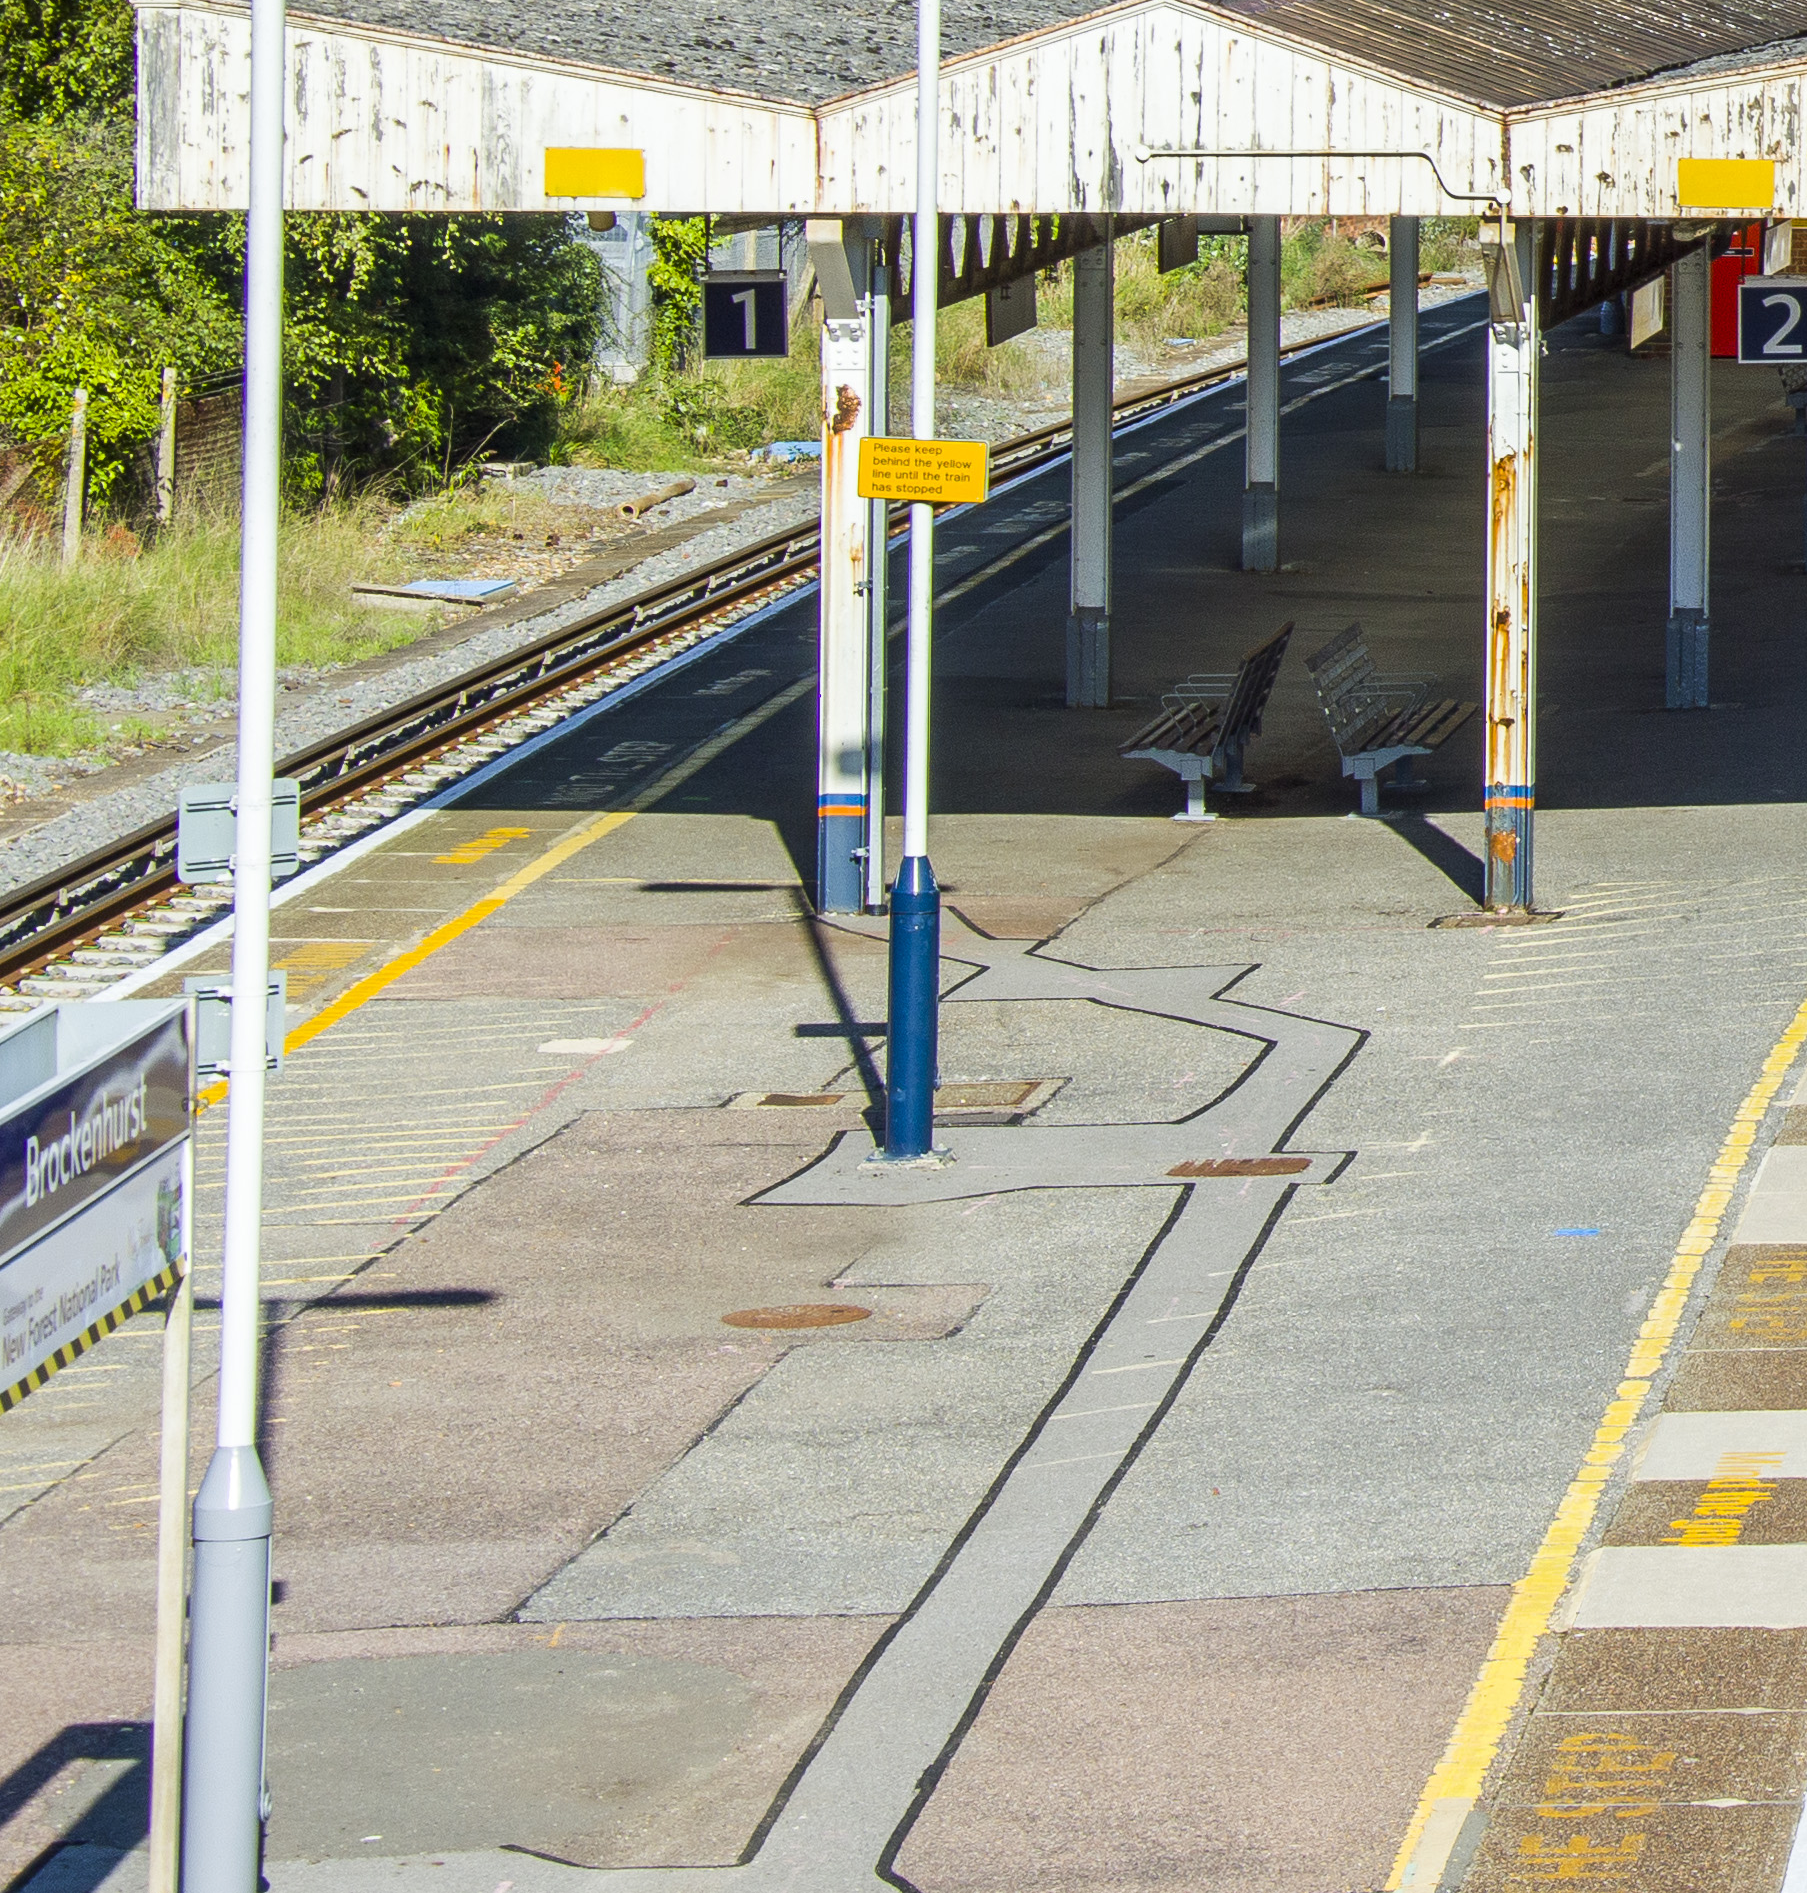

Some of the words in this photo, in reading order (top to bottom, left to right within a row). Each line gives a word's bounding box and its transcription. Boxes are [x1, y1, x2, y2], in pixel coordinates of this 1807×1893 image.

[731, 288, 756, 350] 1
[1762, 293, 1803, 354] 2
[872, 456, 911, 467] behind
[914, 458, 932, 468] the
[936, 459, 972, 470] yellow
[873, 443, 911, 454] Please
[914, 445, 943, 456] keep
[871, 483, 892, 492] has
[896, 484, 943, 495] stopped
[872, 469, 892, 479] line
[895, 471, 918, 480] until
[922, 472, 941, 481] the
[945, 472, 971, 482] train
[26, 1072, 148, 1208] Brockenhurst
[2, 1331, 27, 1370] New
[28, 1302, 58, 1351] Forest
[59, 1264, 100, 1328] National
[101, 1251, 121, 1297] Park
